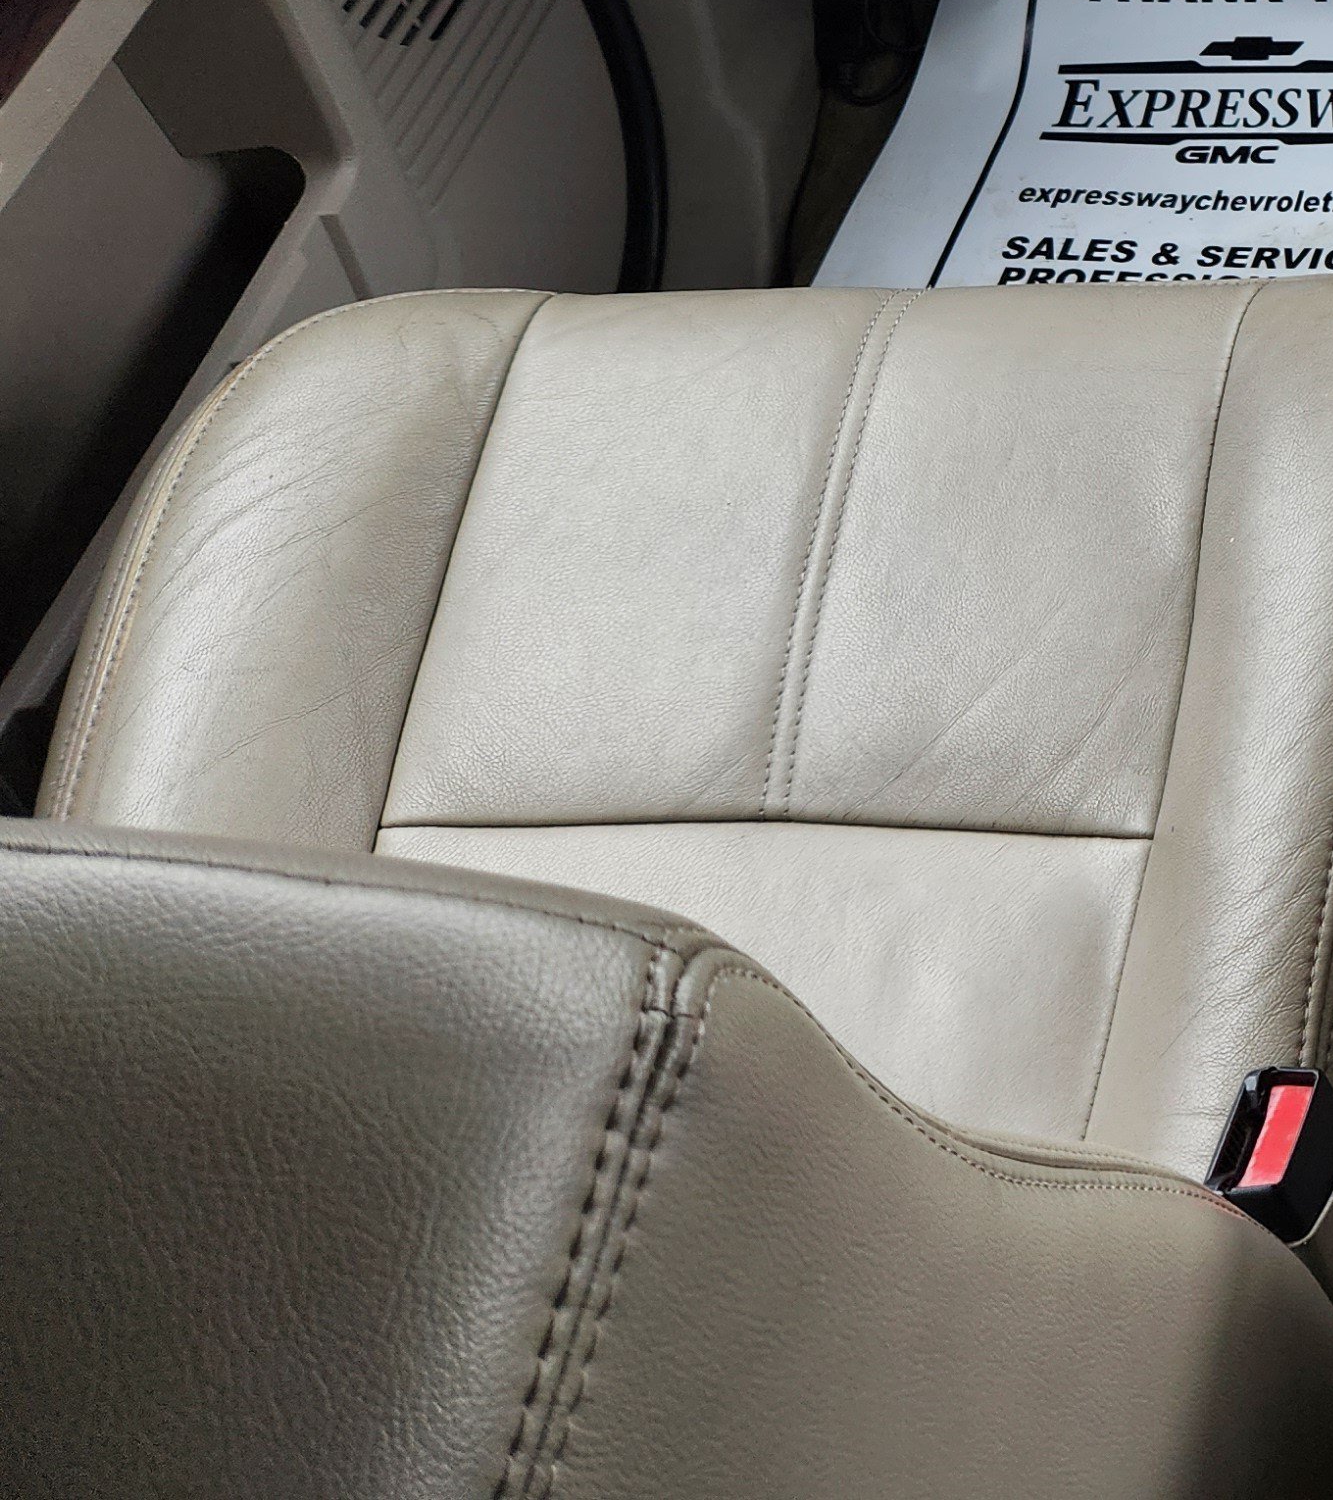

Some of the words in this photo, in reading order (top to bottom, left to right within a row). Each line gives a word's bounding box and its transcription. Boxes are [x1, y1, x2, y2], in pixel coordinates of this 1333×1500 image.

[1175, 145, 1280, 165] GMC
[1001, 235, 1138, 264] SALES
[1152, 242, 1181, 267] &
